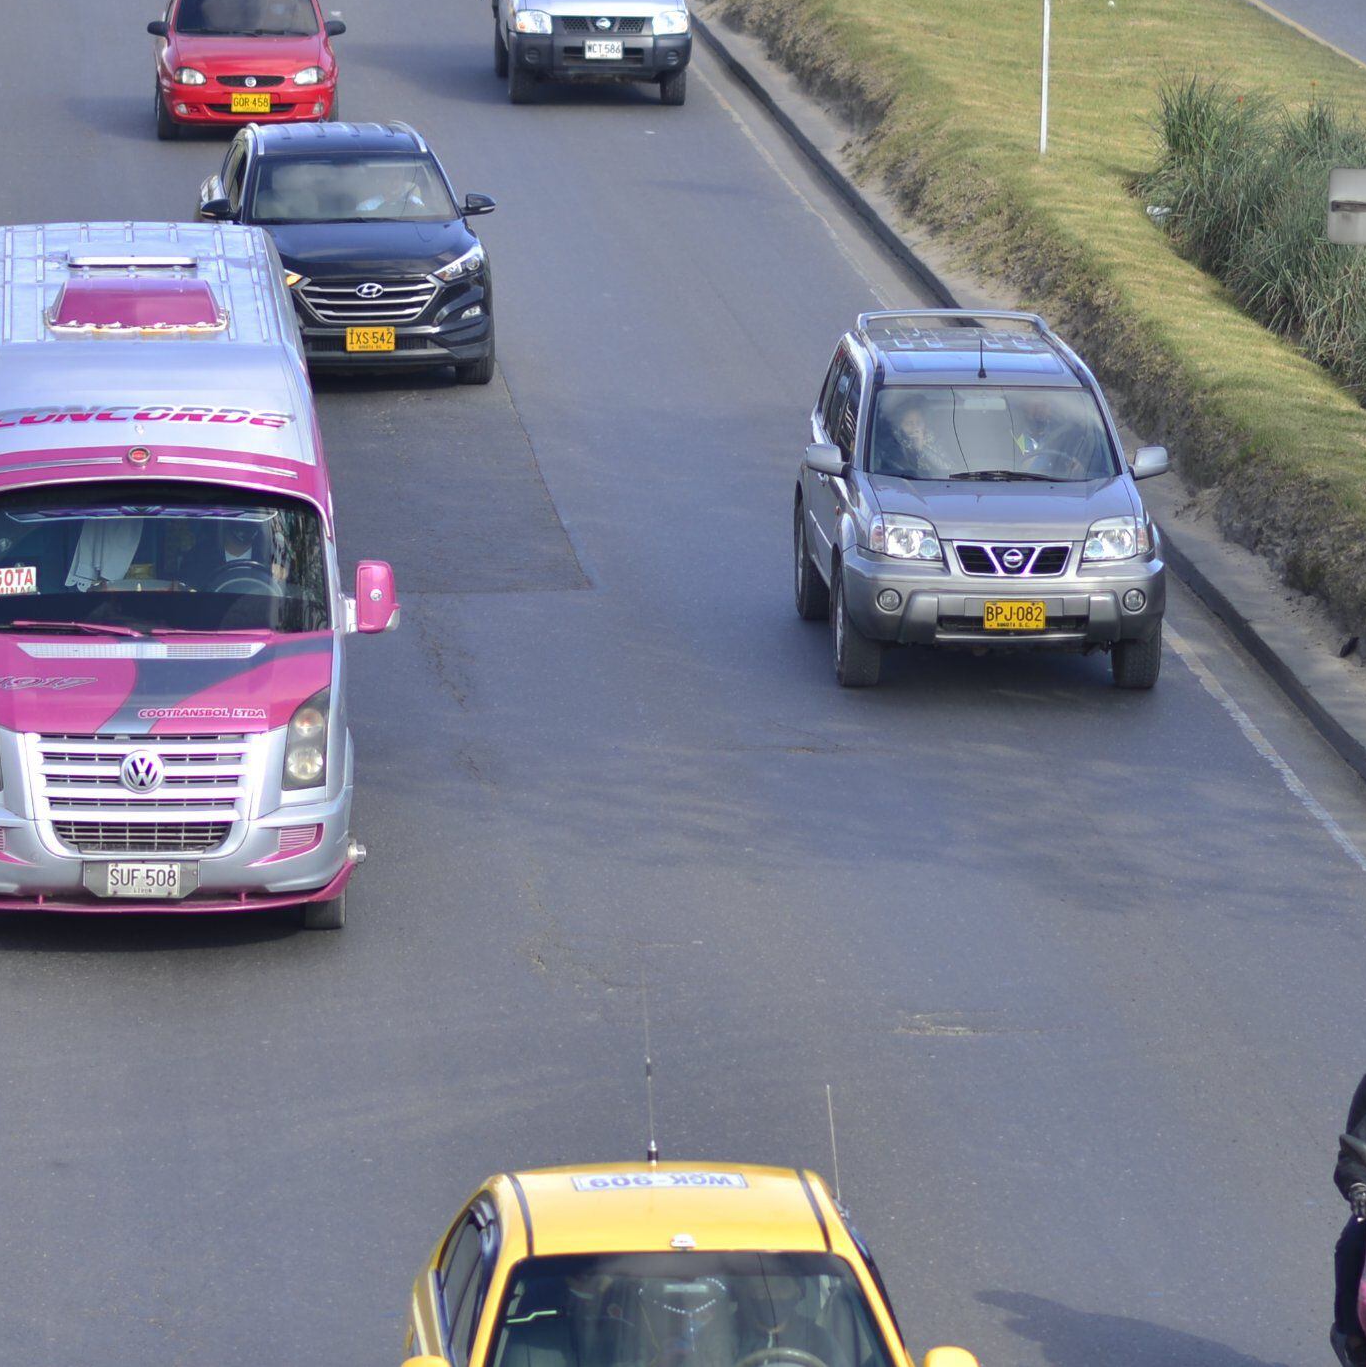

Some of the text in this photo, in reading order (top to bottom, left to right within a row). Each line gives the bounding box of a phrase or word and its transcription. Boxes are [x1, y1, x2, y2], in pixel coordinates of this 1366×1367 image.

[137, 707, 267, 719] COOTRANSBOL LTDA
[109, 867, 177, 888] SUF 508
